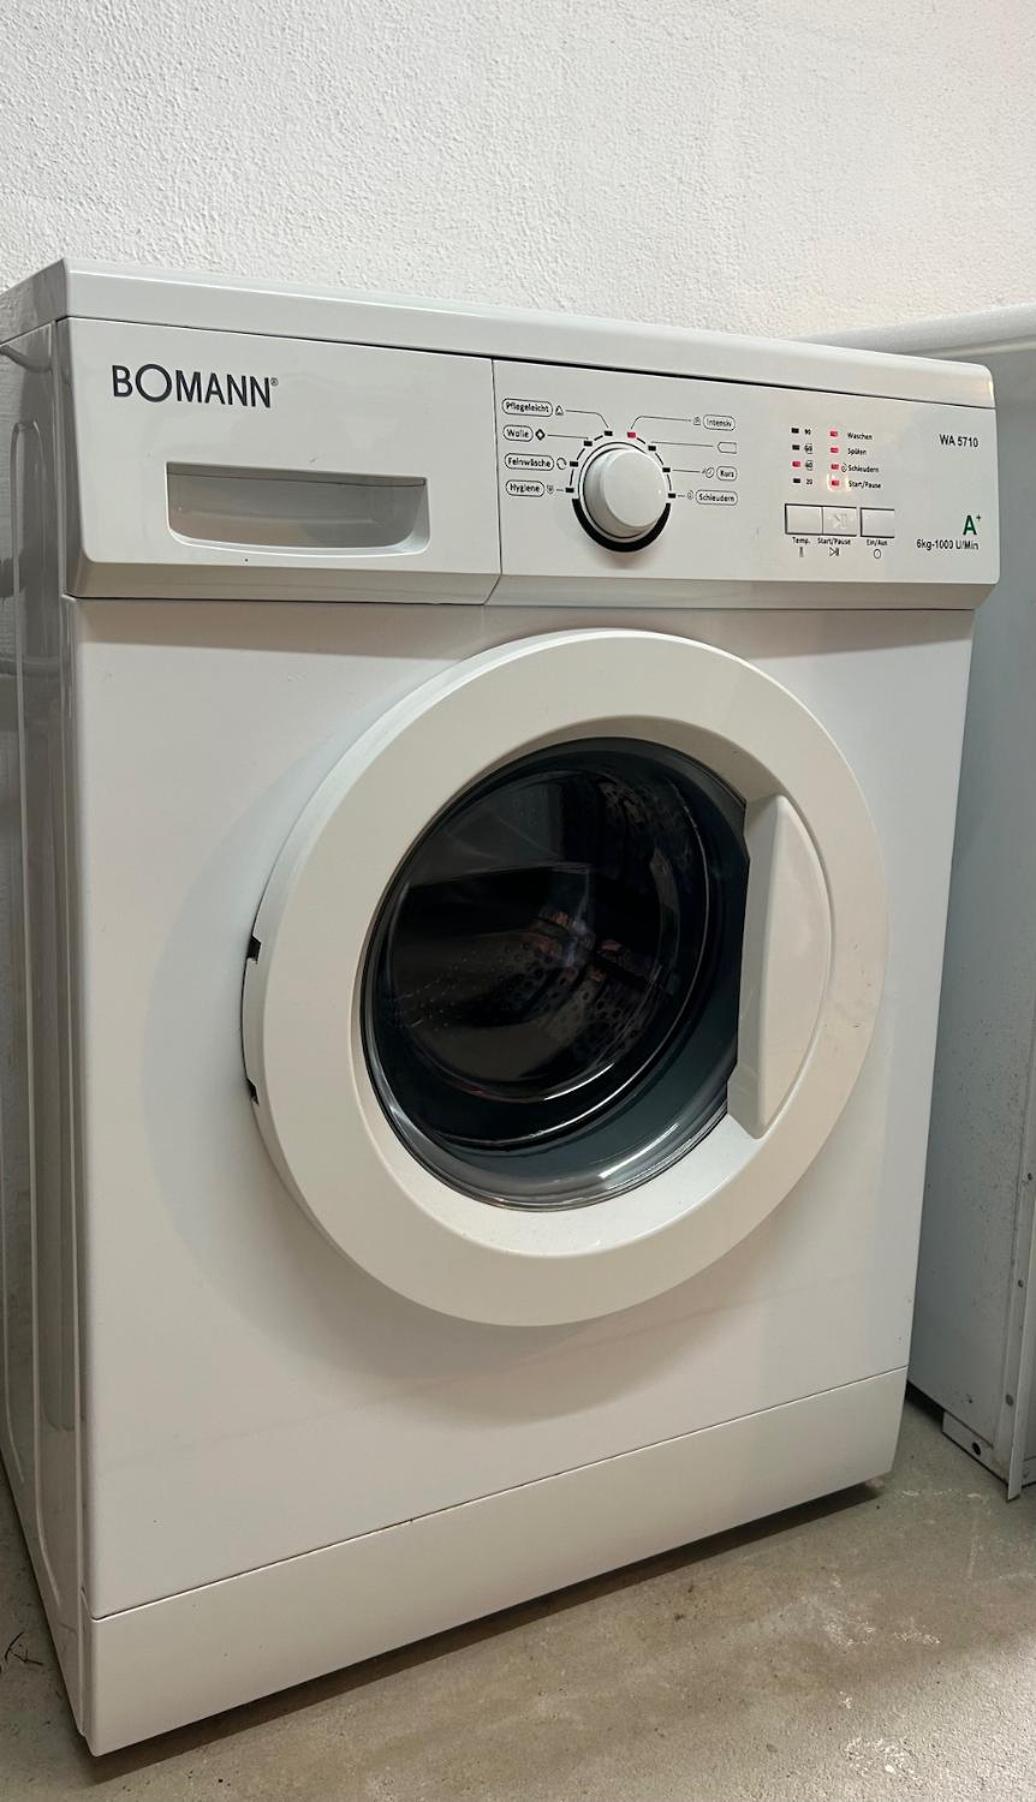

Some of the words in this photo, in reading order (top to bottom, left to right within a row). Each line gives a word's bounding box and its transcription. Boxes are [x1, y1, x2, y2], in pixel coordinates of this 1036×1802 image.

[506, 429, 529, 438] Wolle
[847, 432, 873, 441] Waschen
[939, 434, 956, 446] WA
[957, 436, 979, 448] 5710
[847, 448, 867, 456] Spülen
[507, 457, 552, 468] Feinwäsche
[848, 465, 880, 473] Schleudern
[510, 483, 541, 493] Hygiene
[848, 480, 882, 489] Start/Pause
[698, 493, 736, 503] Schleudern
